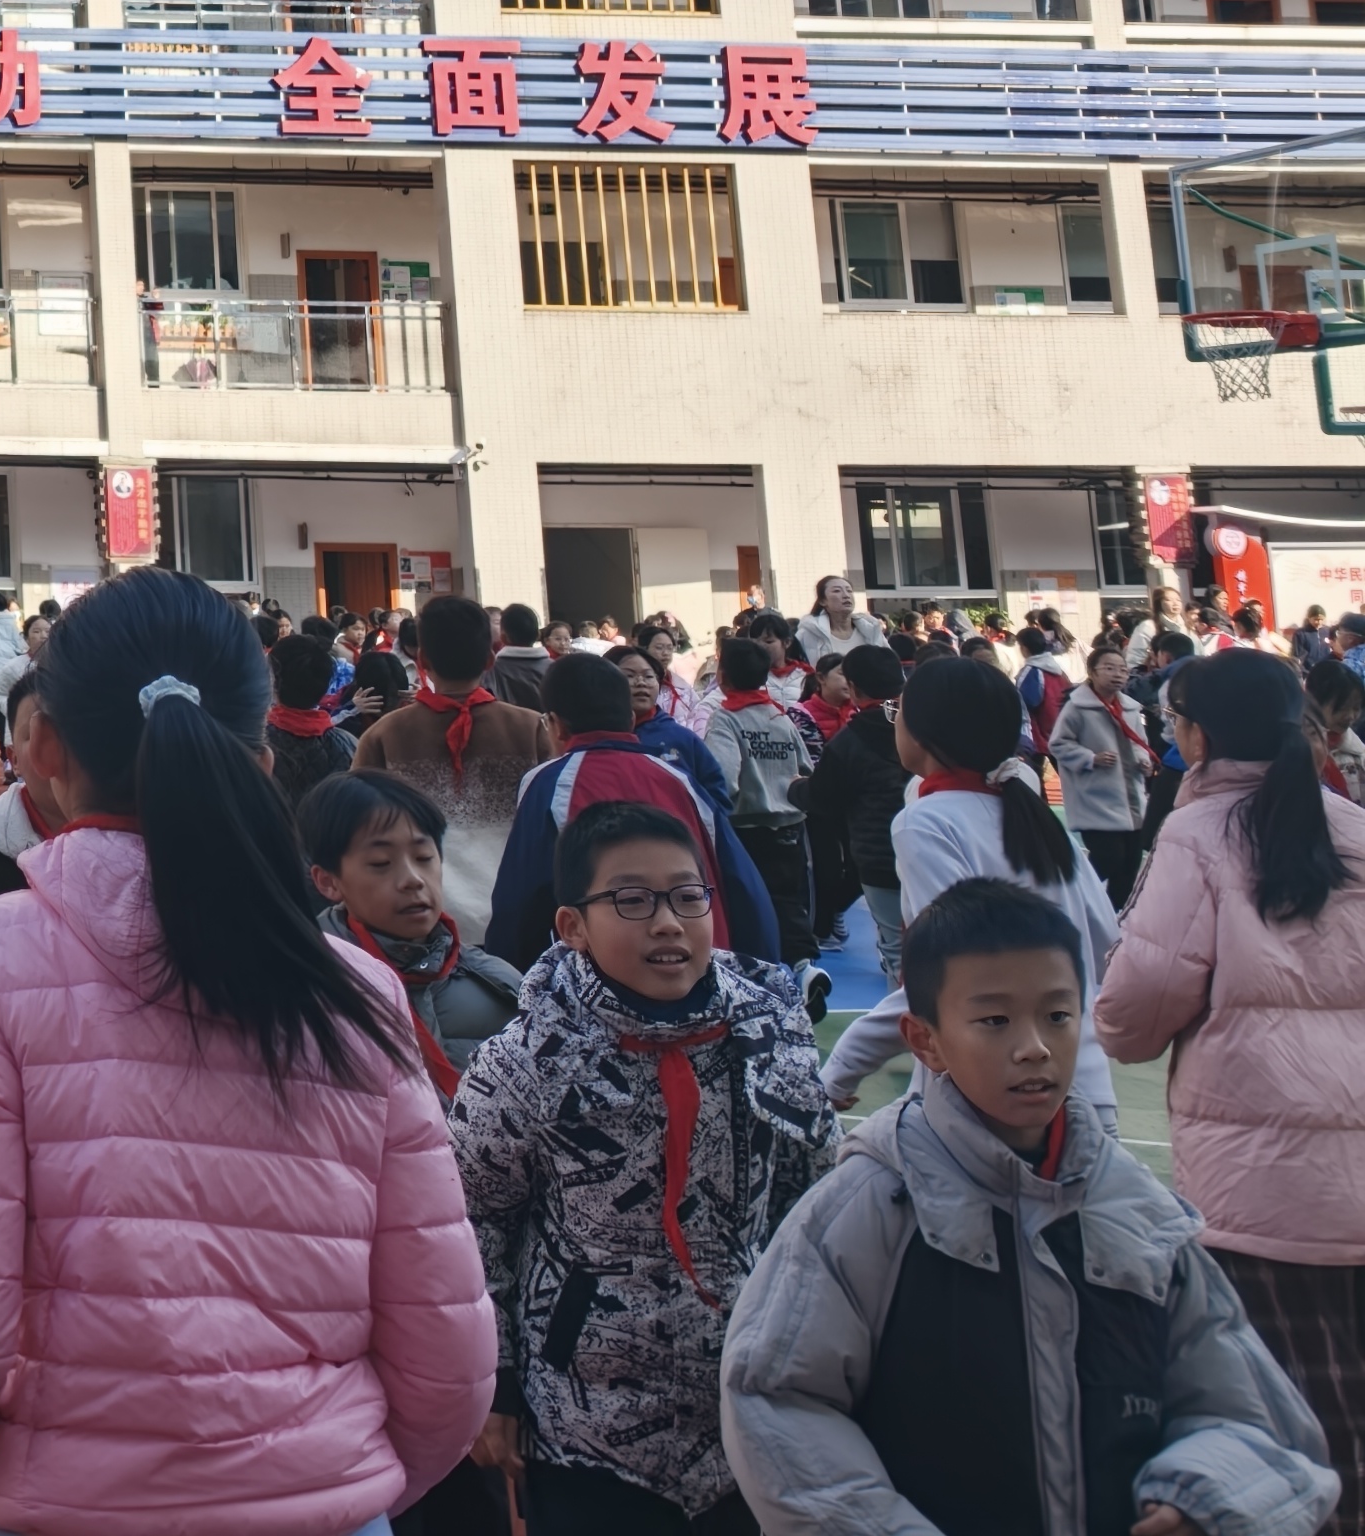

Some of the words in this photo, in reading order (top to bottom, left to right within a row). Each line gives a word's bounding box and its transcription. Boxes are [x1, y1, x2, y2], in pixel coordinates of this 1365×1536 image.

[272, 37, 819, 146] 全面发展
[1319, 567, 1365, 582] 中华民
